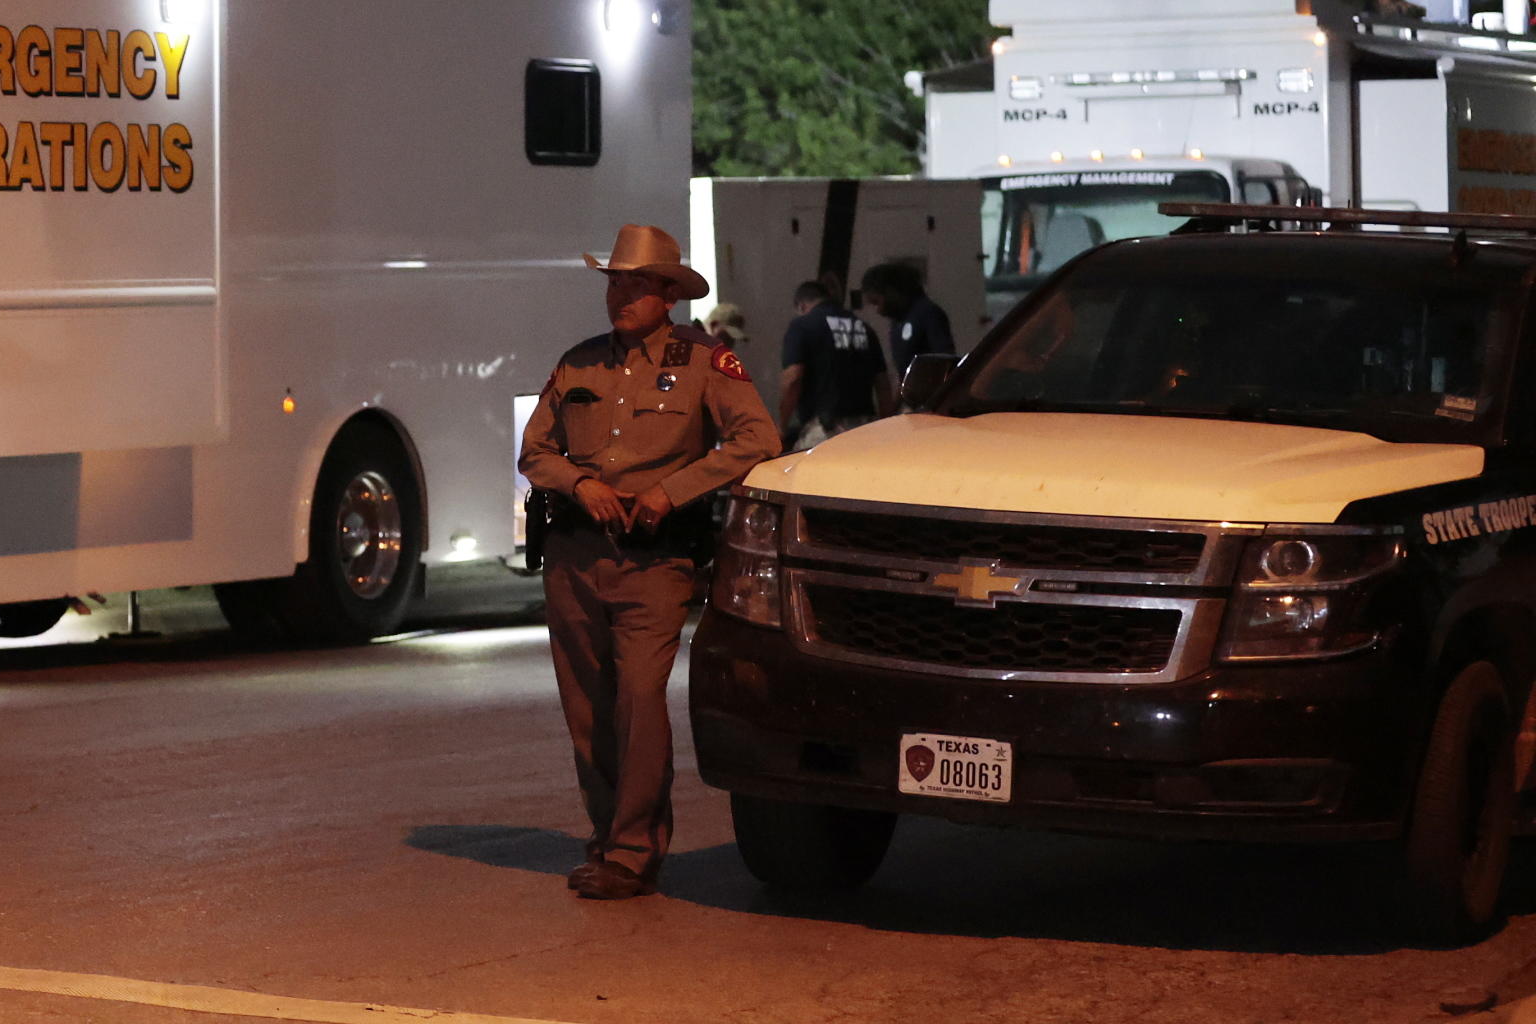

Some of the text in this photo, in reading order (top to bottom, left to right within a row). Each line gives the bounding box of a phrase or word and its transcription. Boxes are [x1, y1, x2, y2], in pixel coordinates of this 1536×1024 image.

[1003, 107, 1068, 123] MCP-4
[1253, 101, 1321, 116] MCP-4
[1422, 505, 1481, 545] STATE
[936, 739, 980, 755] TEXAS
[939, 758, 1003, 791] 08063
